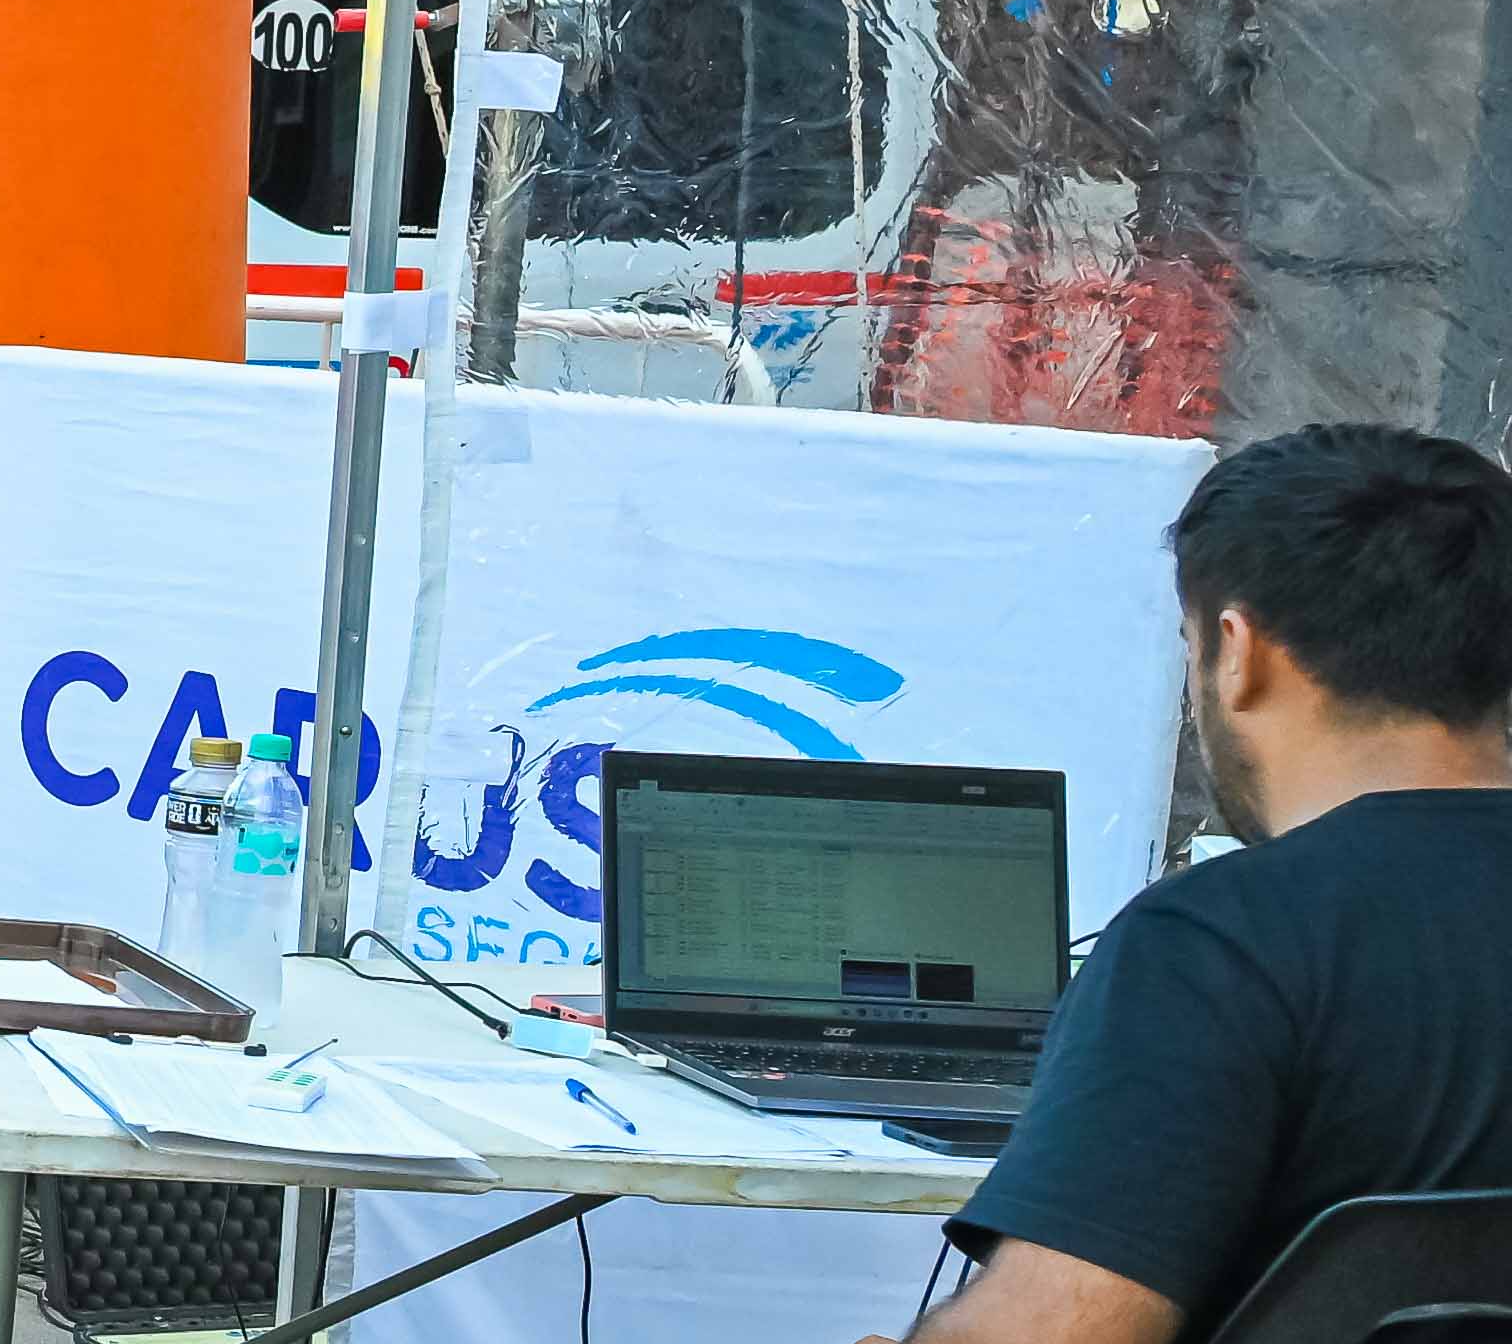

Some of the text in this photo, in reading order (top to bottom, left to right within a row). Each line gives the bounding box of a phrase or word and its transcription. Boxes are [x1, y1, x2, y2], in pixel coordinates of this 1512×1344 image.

[254, 11, 334, 71] 100
[21, 650, 602, 923] CARUS
[822, 1025, 856, 1039] acer
